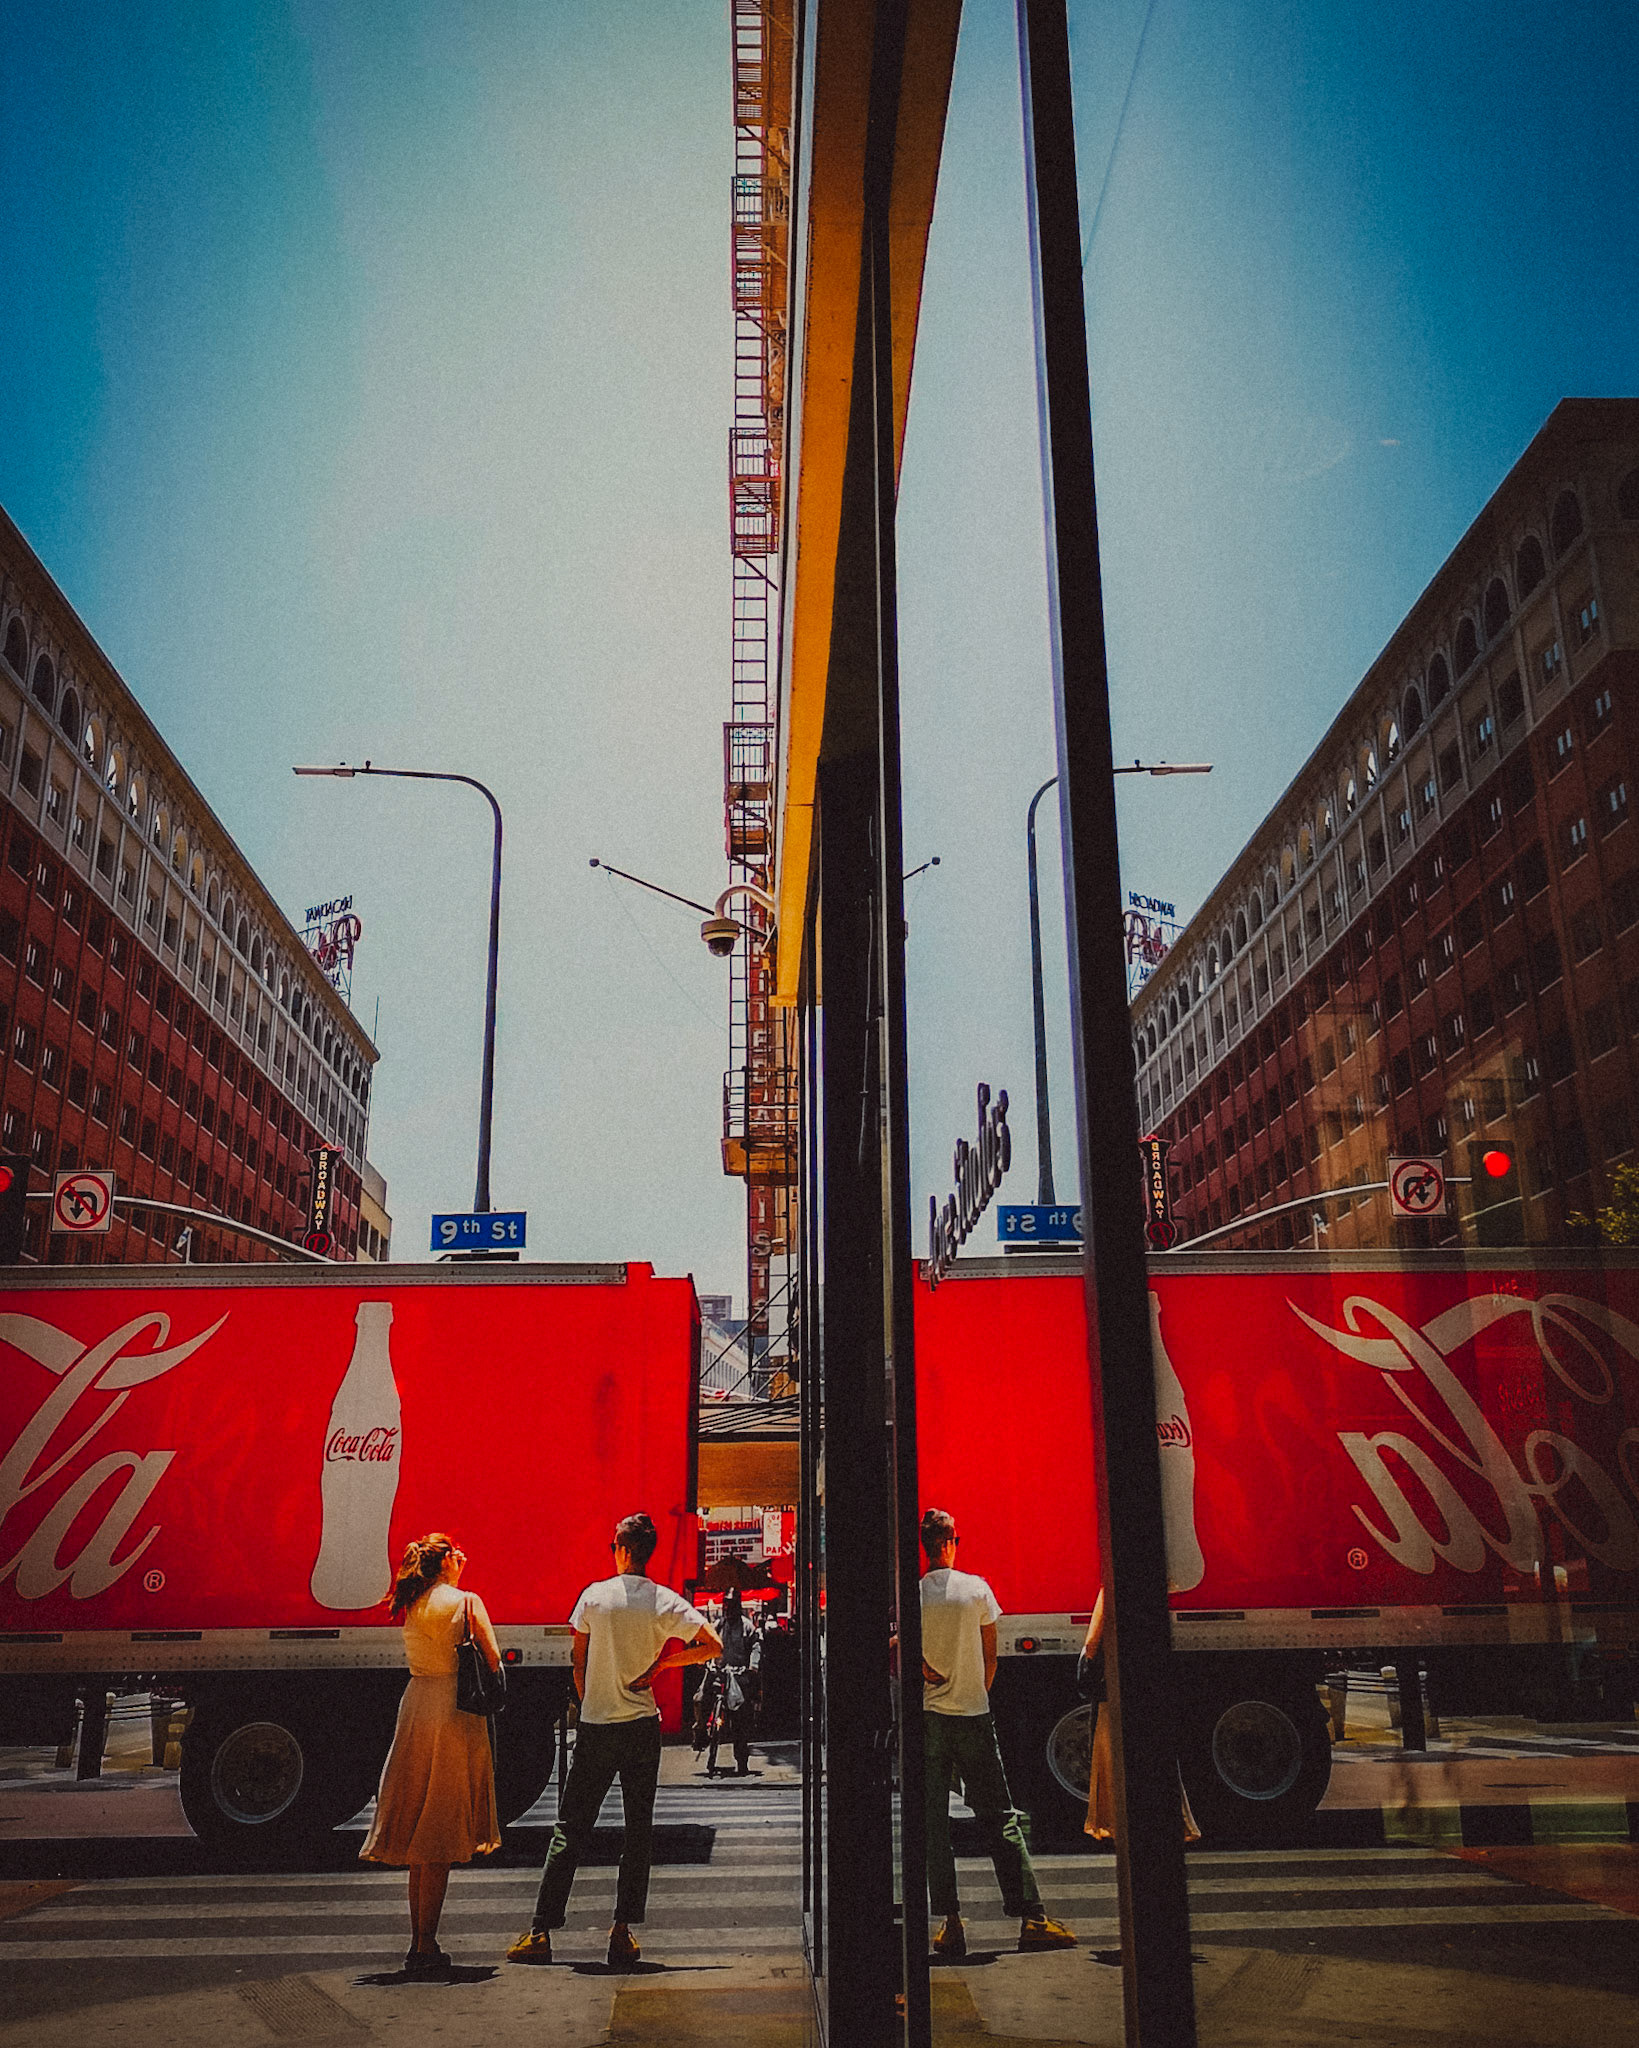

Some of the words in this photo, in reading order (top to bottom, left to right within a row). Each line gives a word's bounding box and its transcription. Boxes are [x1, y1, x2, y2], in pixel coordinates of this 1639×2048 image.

[315, 1151, 329, 1230] BROADWAY
[440, 1219, 481, 1245] 9th
[491, 1221, 518, 1240] St
